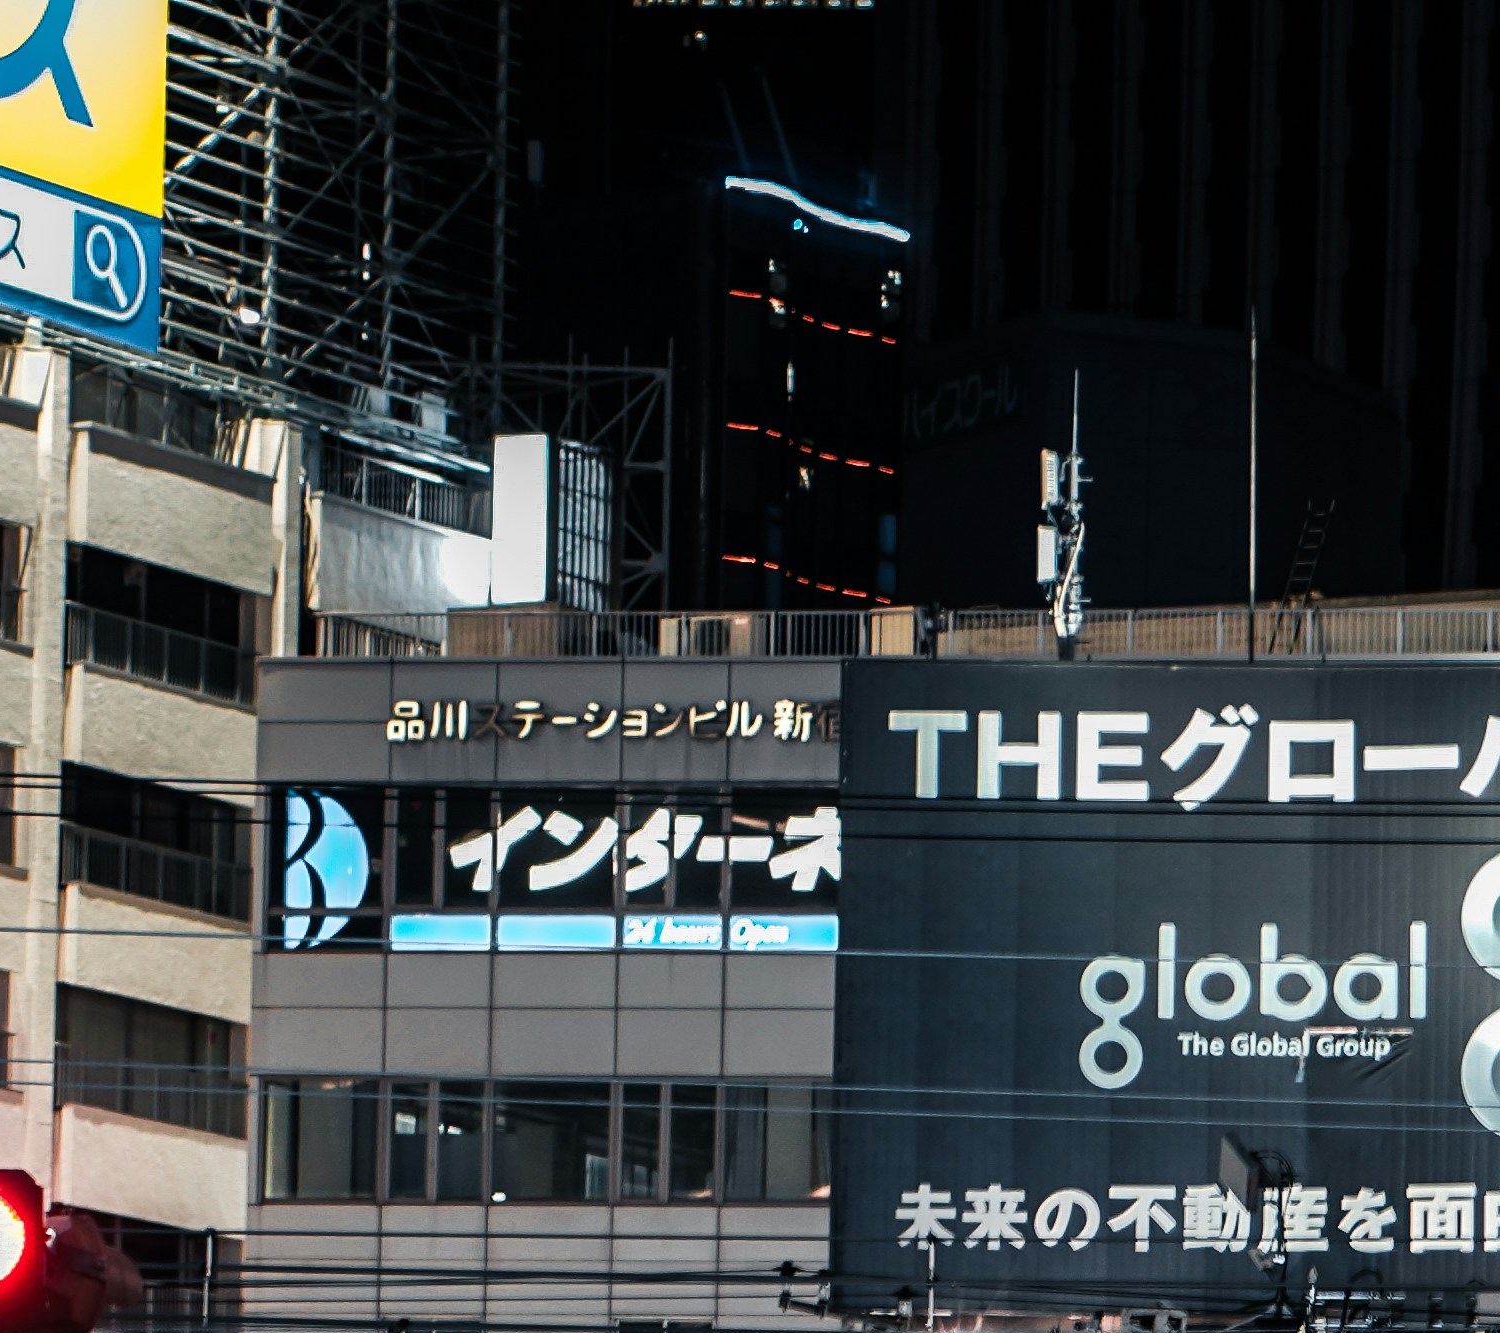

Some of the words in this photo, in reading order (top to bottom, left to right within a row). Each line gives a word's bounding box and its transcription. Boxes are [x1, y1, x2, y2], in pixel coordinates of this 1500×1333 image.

[1078, 920, 1428, 1090] global
[1177, 1032, 1225, 1057] The
[1230, 1031, 1309, 1059] Global
[1316, 1032, 1392, 1062] Group
